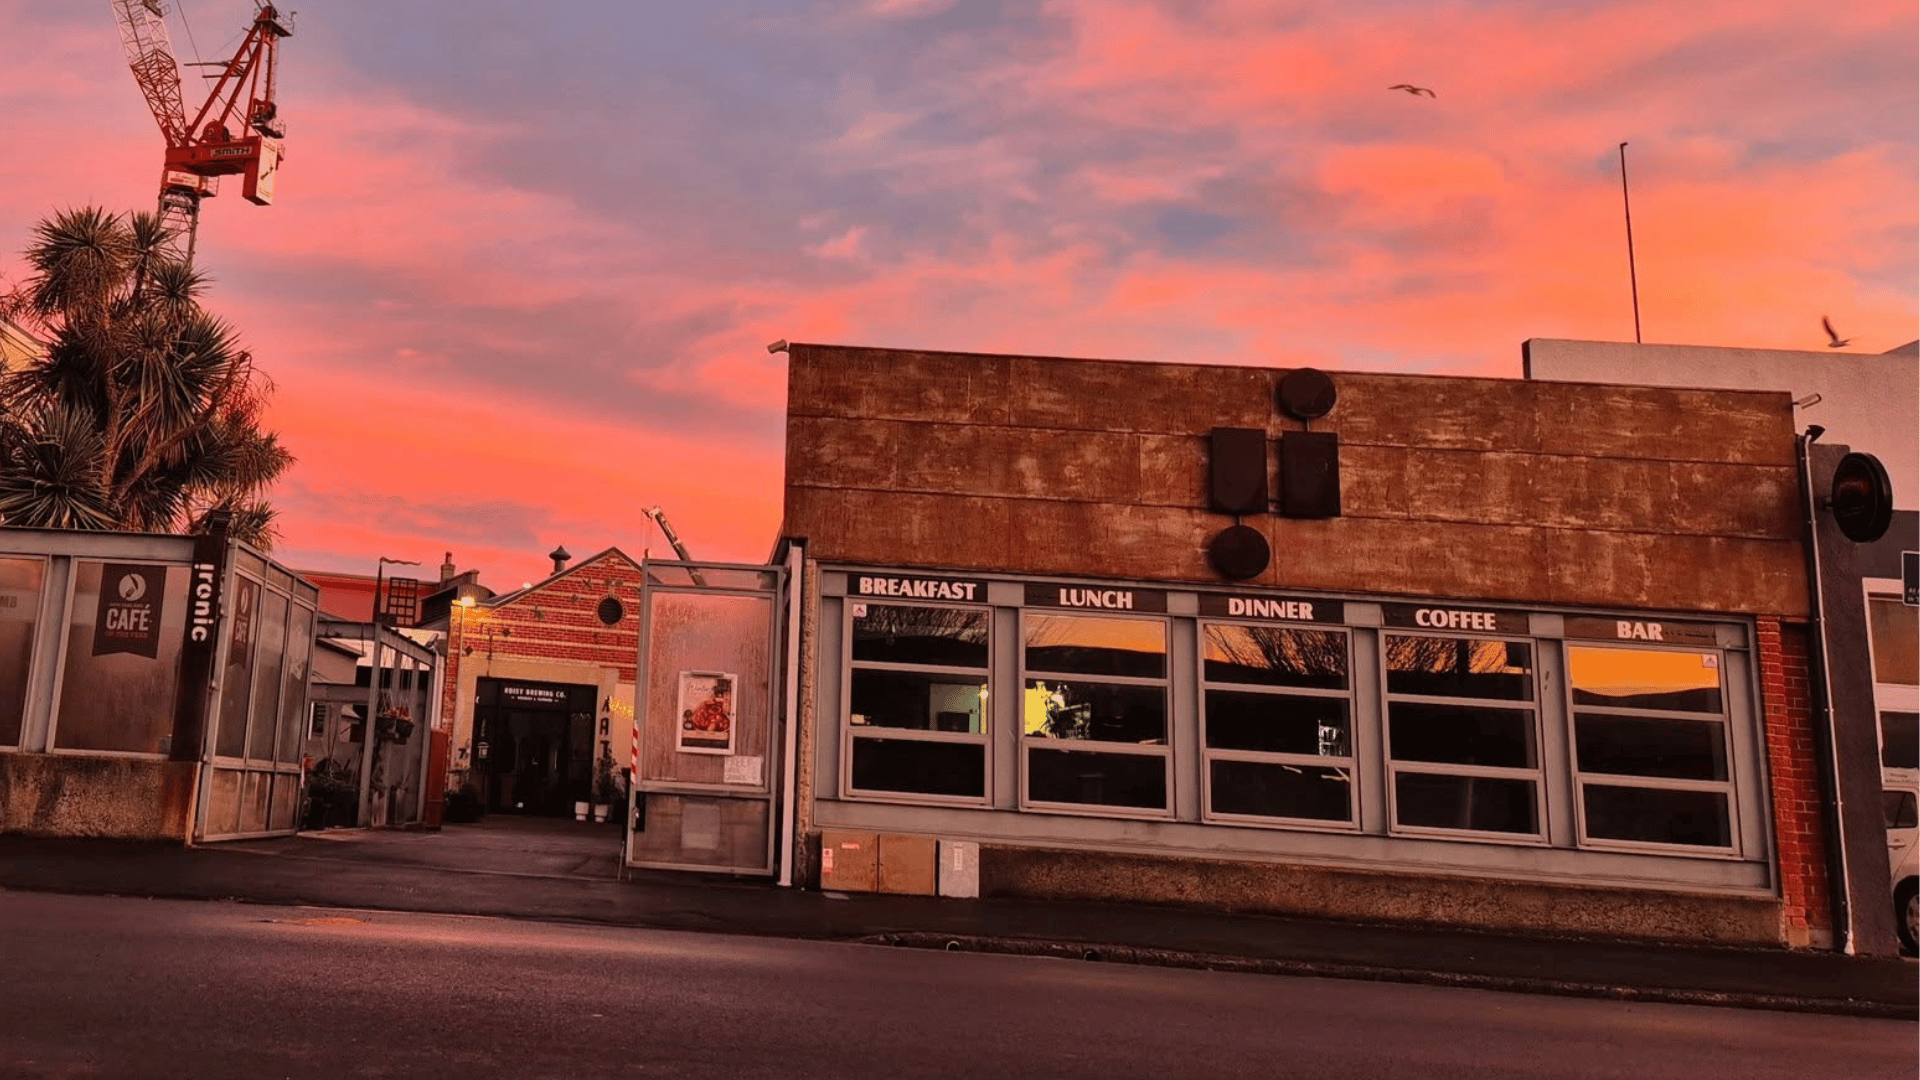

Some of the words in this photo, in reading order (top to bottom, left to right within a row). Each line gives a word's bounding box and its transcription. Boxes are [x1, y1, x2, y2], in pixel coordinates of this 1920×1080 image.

[859, 577, 977, 601] BREAKFAST
[1059, 588, 1134, 609] LUNCH
[106, 603, 151, 632] CAFÉ
[1227, 597, 1314, 620] DINNER
[1414, 608, 1496, 631] COFFEE
[1616, 620, 1664, 641] BAR
